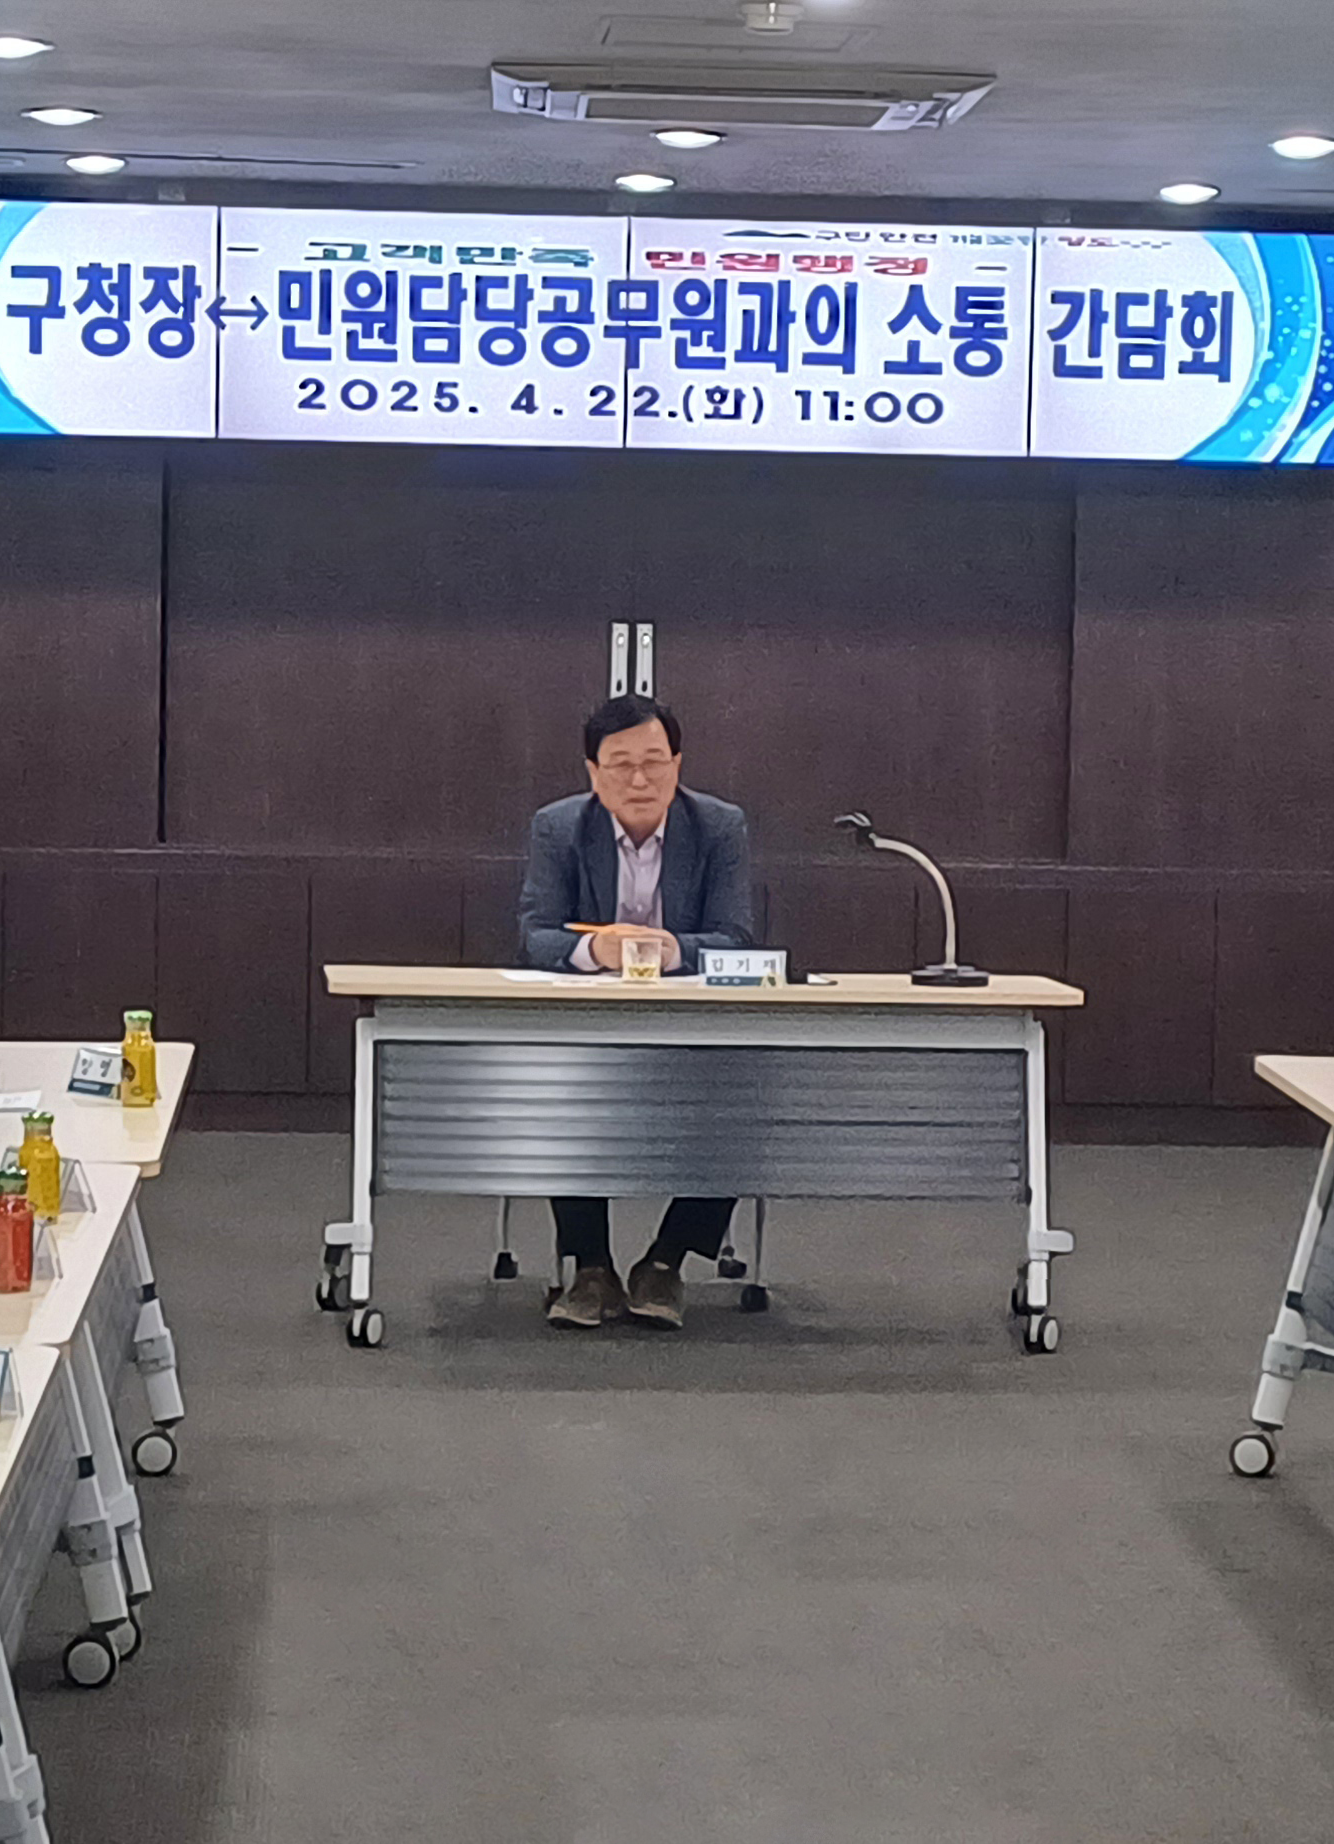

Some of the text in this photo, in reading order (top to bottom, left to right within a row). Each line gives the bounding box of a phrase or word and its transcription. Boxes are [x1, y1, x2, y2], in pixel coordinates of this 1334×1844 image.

[304, 241, 929, 276] 고객만족 민원행정
[6, 262, 1235, 383] 구청장 민원담당공무원과의 소통 간담회
[297, 377, 480, 415] 2025.
[510, 381, 563, 417] 4.
[794, 389, 945, 426] 11:00
